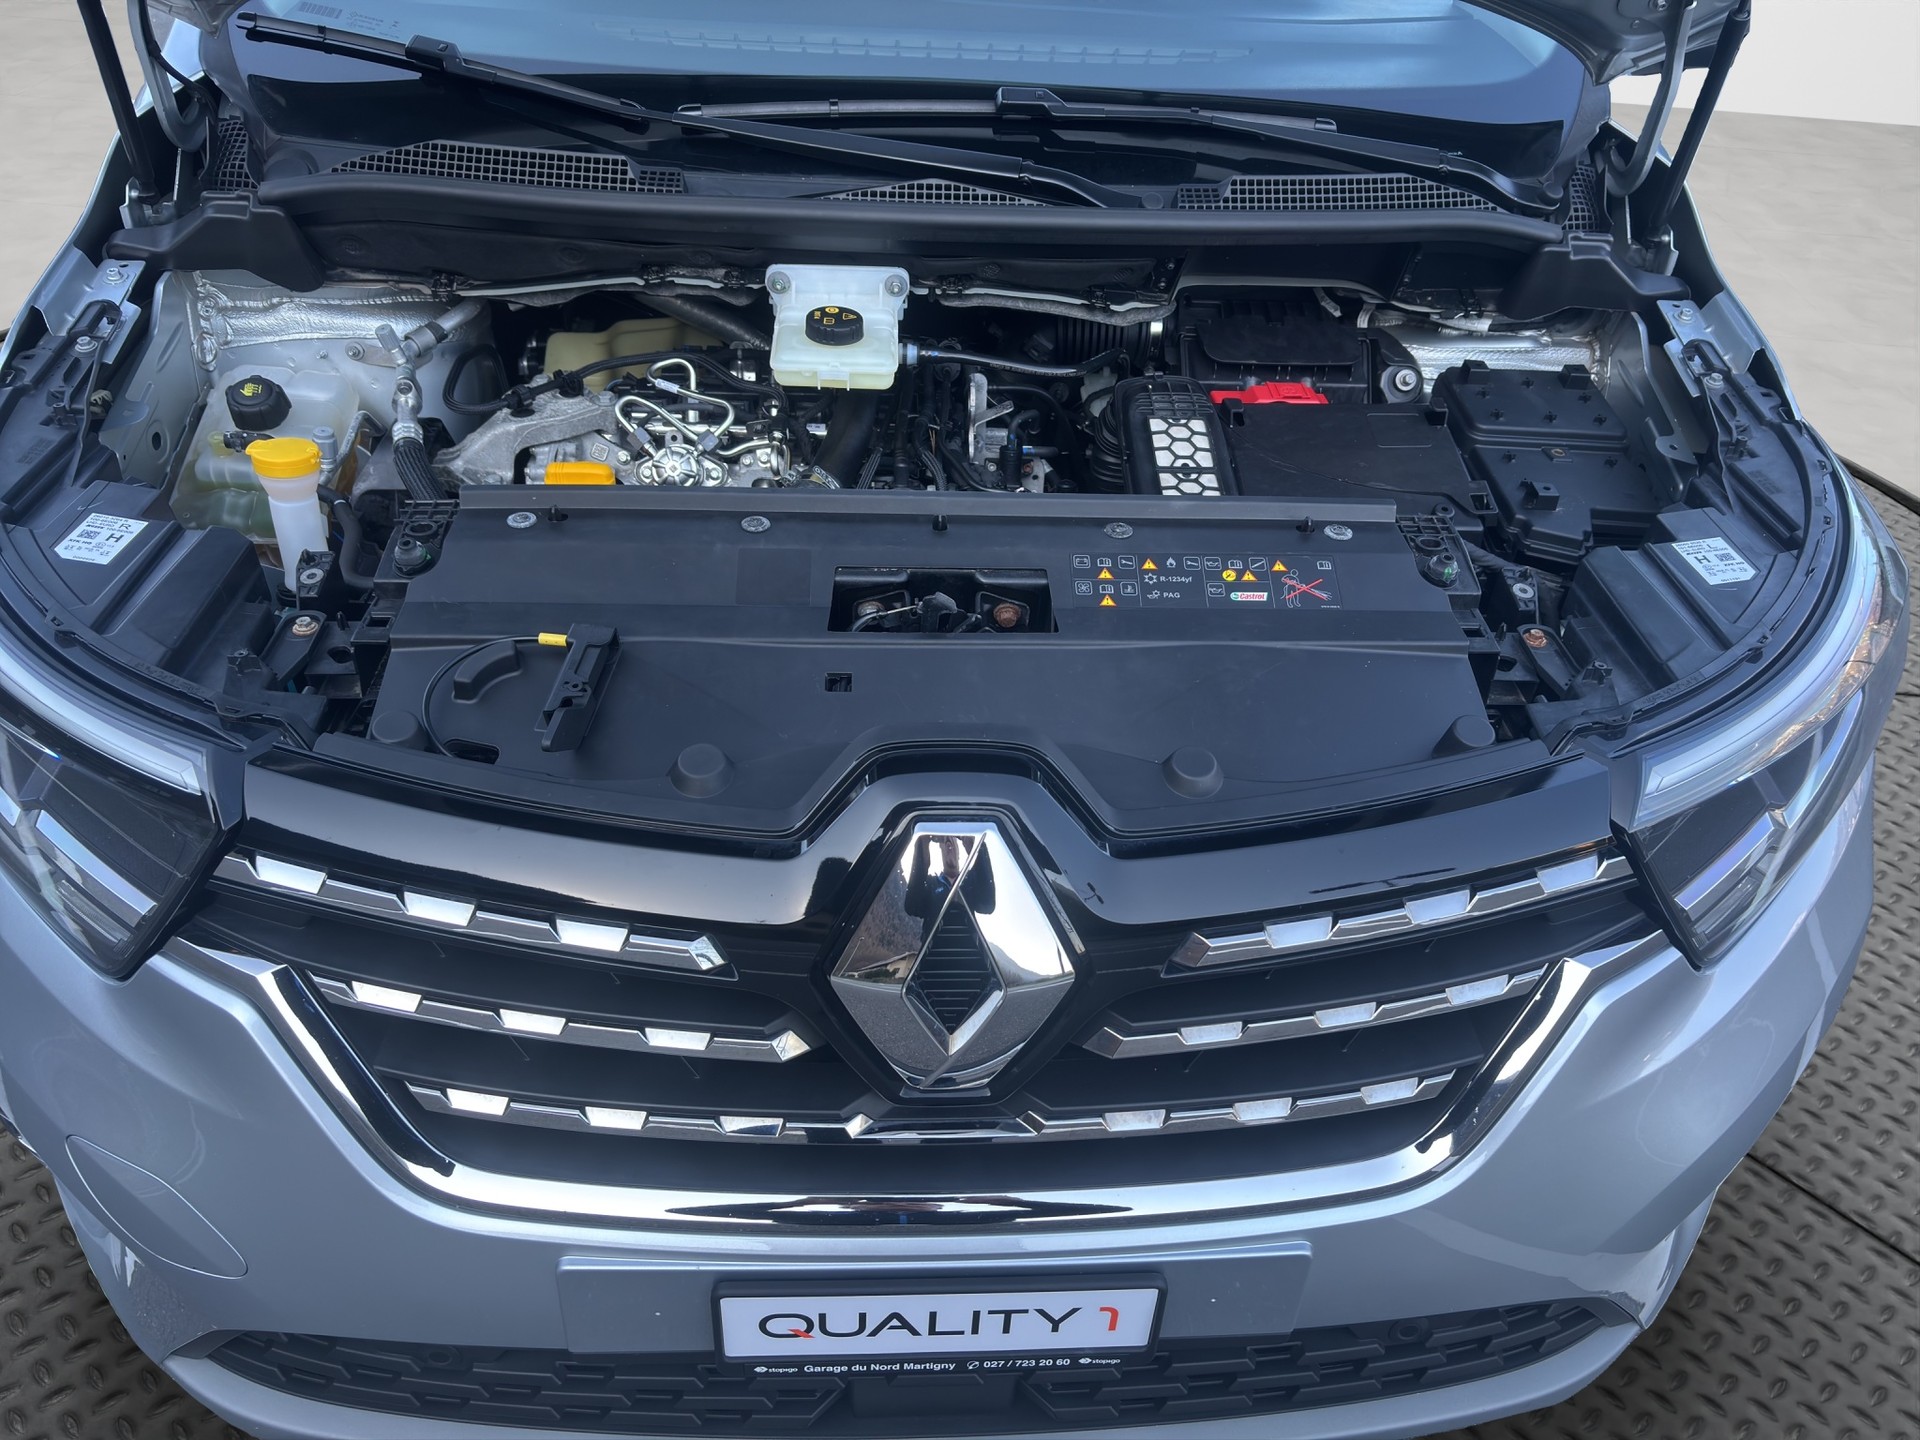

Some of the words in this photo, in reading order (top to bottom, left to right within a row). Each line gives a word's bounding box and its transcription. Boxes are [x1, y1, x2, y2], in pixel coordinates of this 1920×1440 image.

[105, 533, 124, 543] H
[1694, 555, 1711, 564] H
[758, 1307, 1083, 1339] QUALITY
[1099, 1306, 1119, 1331] 1
[804, 1365, 848, 1374] Garage
[870, 1363, 900, 1371] Nord
[903, 1362, 956, 1371] Martigny
[983, 1360, 1004, 1368] 027
[1015, 1359, 1036, 1367] 723
[1055, 1358, 1071, 1366] 60
